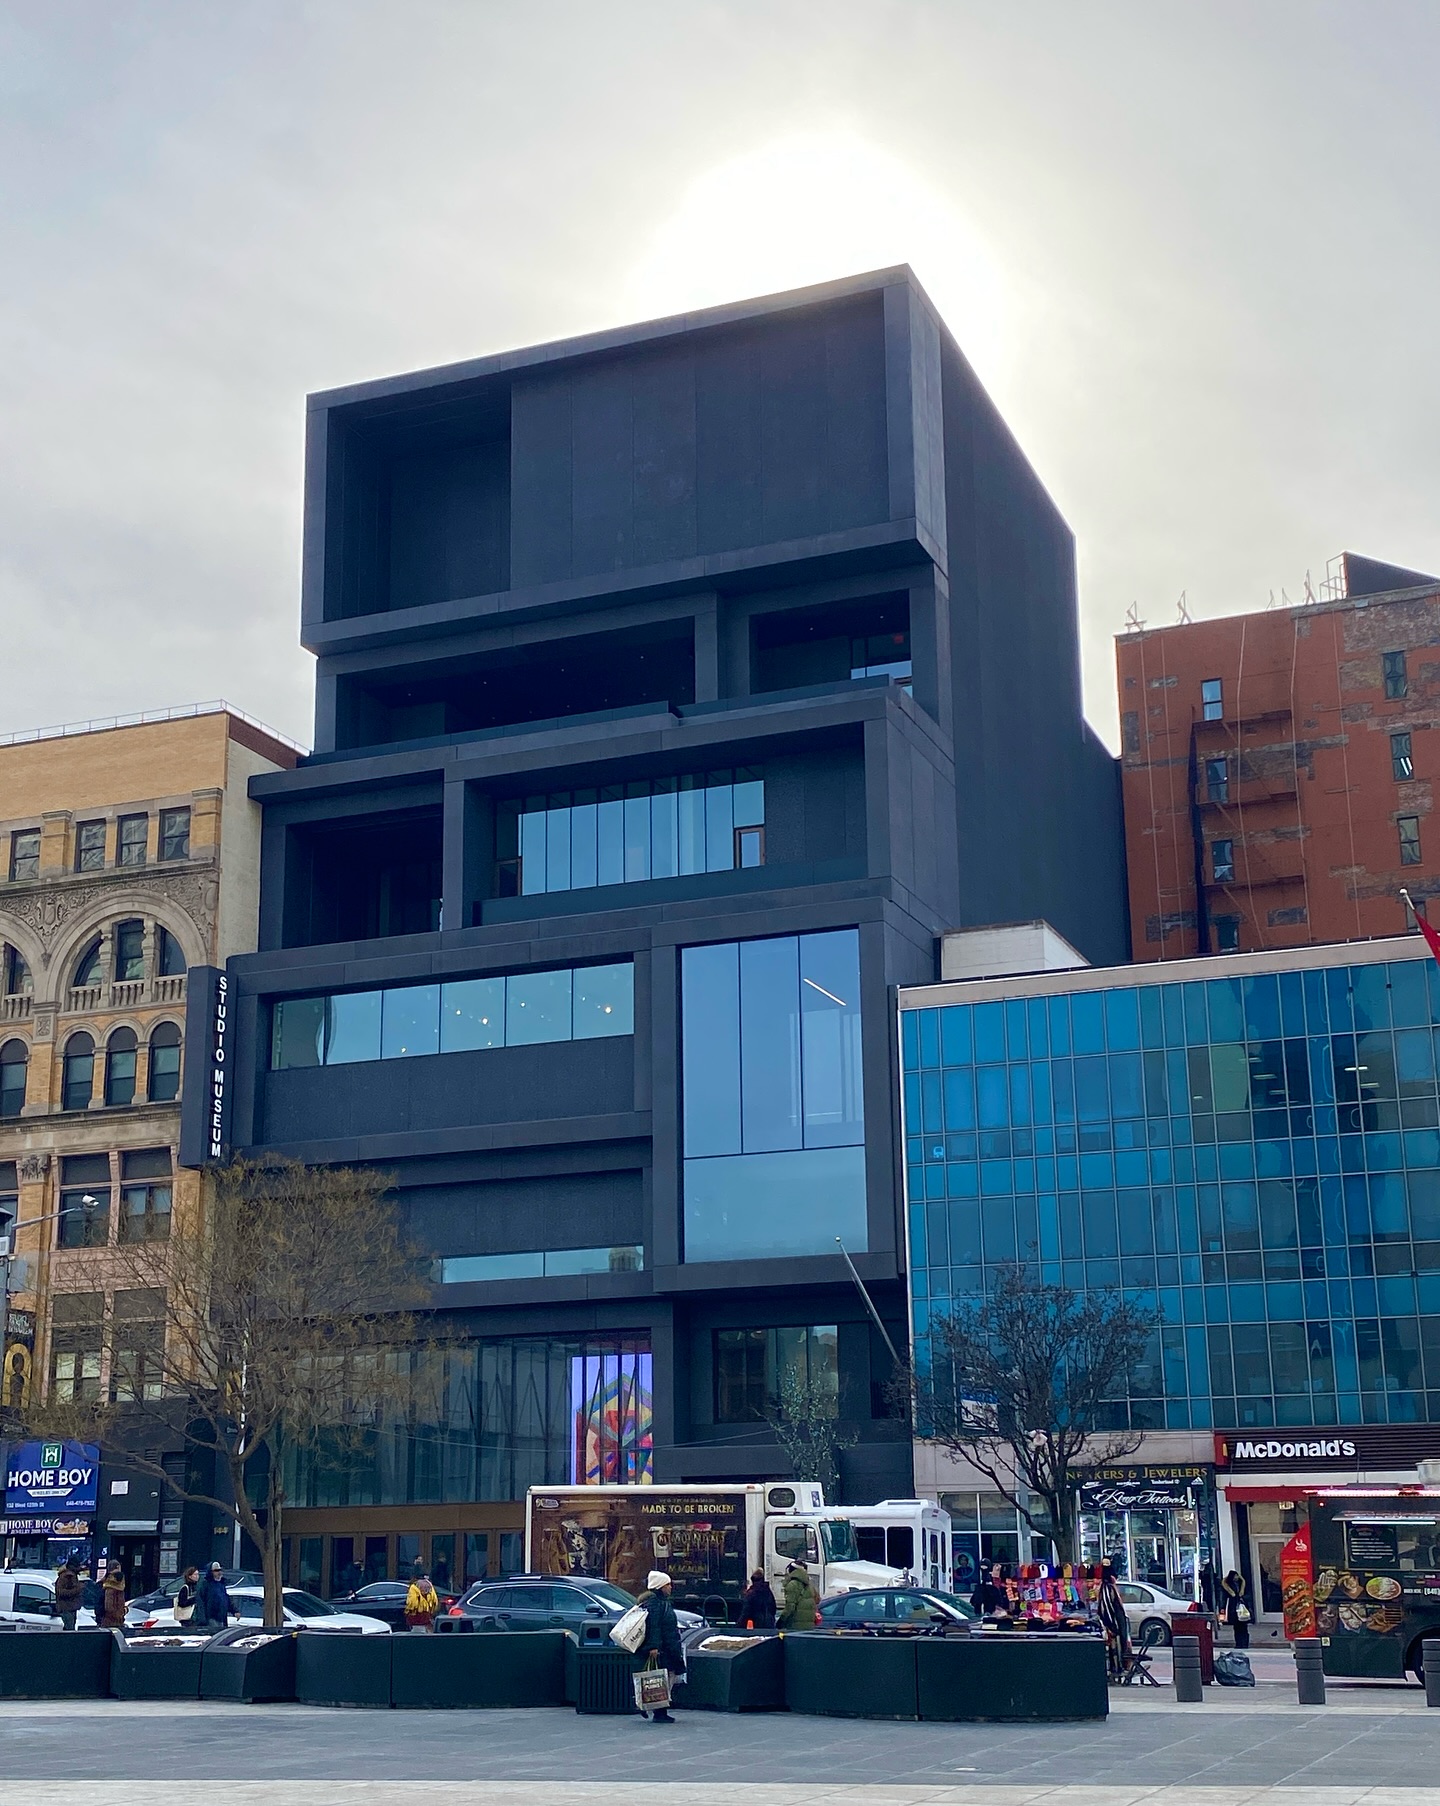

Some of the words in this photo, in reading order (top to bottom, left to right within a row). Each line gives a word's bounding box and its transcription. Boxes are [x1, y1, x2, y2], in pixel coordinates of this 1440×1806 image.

[214, 976, 227, 1063] STUDIO
[211, 1069, 224, 1157] MUSEUM
[1235, 1439, 1356, 1458] McDonald's
[8, 1470, 54, 1487] HOME
[58, 1468, 92, 1486] BOY
[1142, 1467, 1207, 1479] JEWELERS
[641, 1504, 667, 1514] MADE
[669, 1504, 682, 1514] TO
[684, 1504, 695, 1514] BE
[698, 1504, 734, 1514] BROKEN
[9, 1519, 34, 1529] HOME
[35, 1519, 52, 1529] BOY
